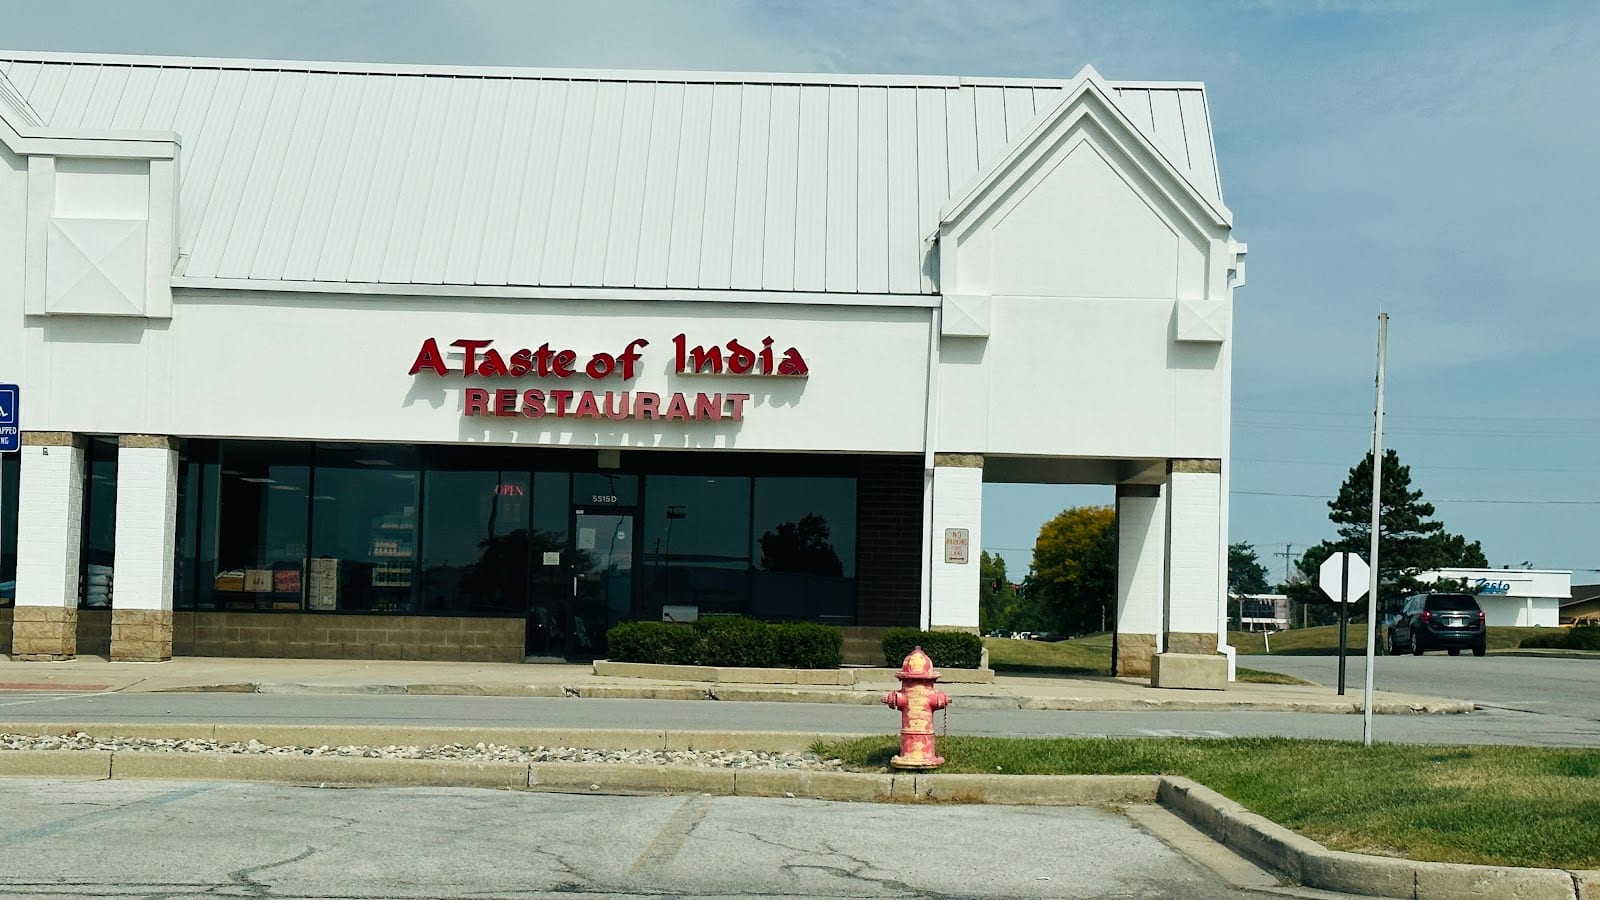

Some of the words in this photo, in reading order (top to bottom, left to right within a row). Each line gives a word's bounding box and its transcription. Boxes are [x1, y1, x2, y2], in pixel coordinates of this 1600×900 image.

[408, 337, 448, 376] A
[450, 339, 577, 378] Taste
[586, 338, 650, 381] of
[672, 333, 810, 376] India
[464, 387, 751, 422] RESTAURANT
[495, 484, 524, 497] OPEN
[592, 495, 617, 503] 5515D
